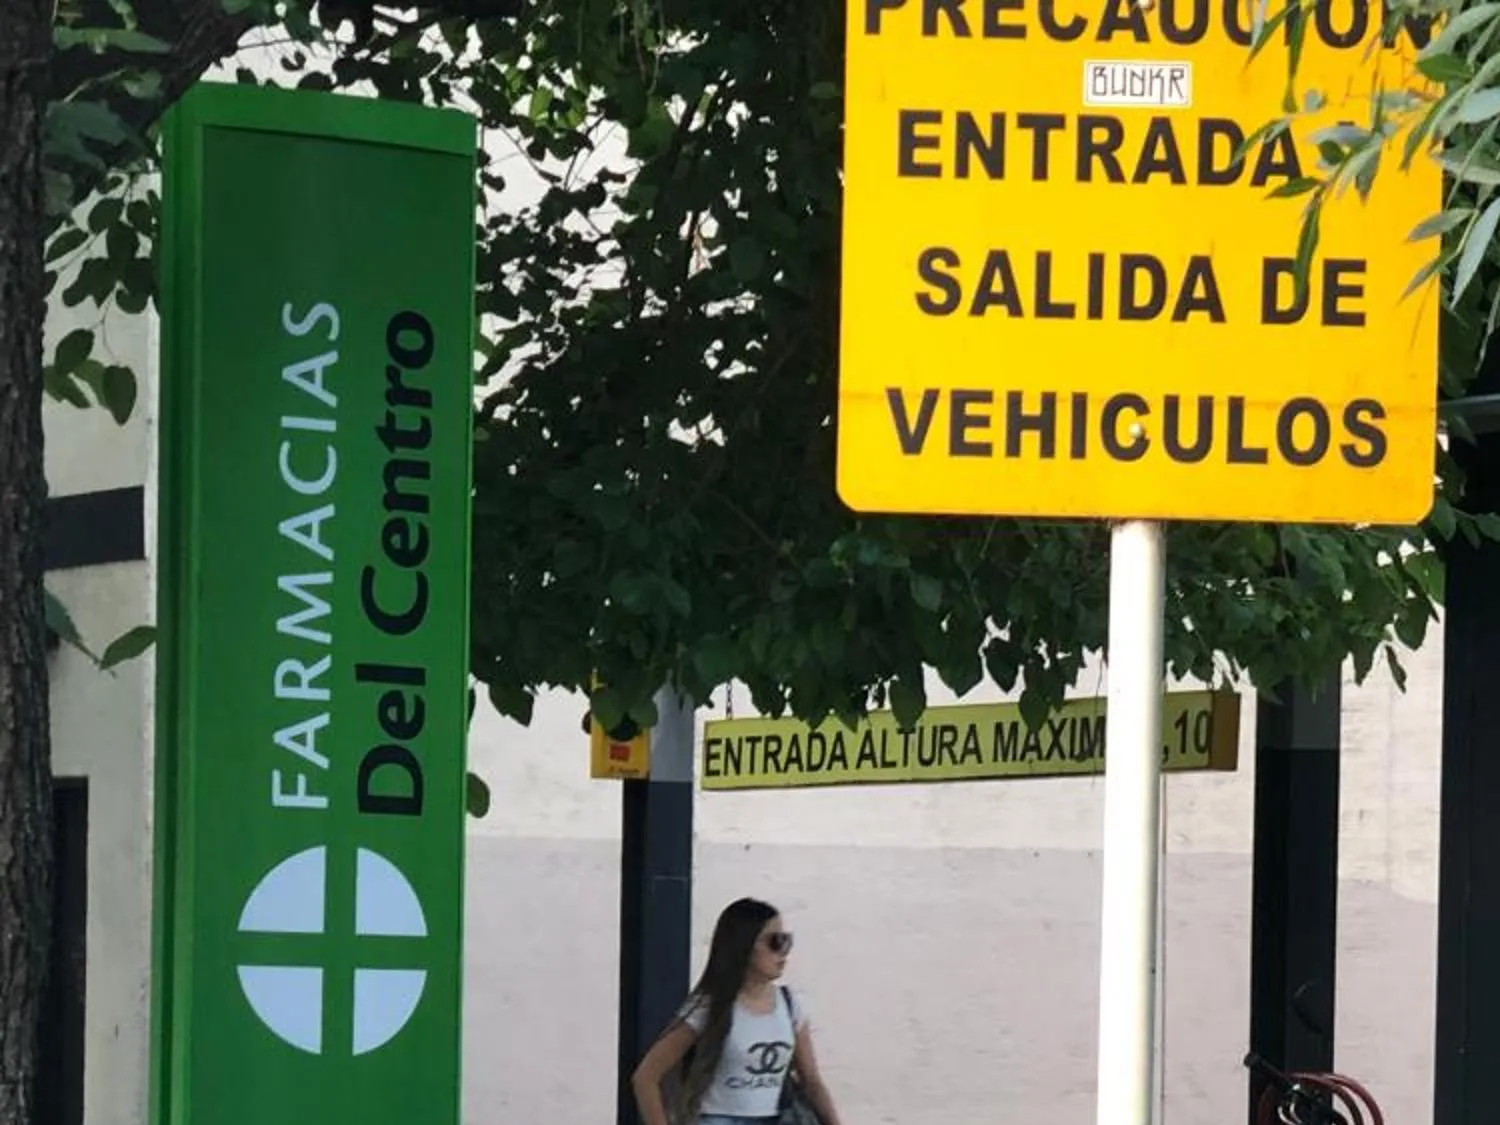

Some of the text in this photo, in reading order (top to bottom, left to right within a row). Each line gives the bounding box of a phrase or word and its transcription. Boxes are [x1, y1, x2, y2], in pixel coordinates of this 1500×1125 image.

[897, 109, 1302, 187] ENTRADA
[915, 247, 1367, 327] SALIDA DE
[886, 387, 1388, 468] VEHICULOS
[272, 301, 341, 810] FARMACIAS
[354, 310, 434, 816] Del Centro
[704, 709, 1213, 777] ENTRADA ALTURA MAXIM ,10
